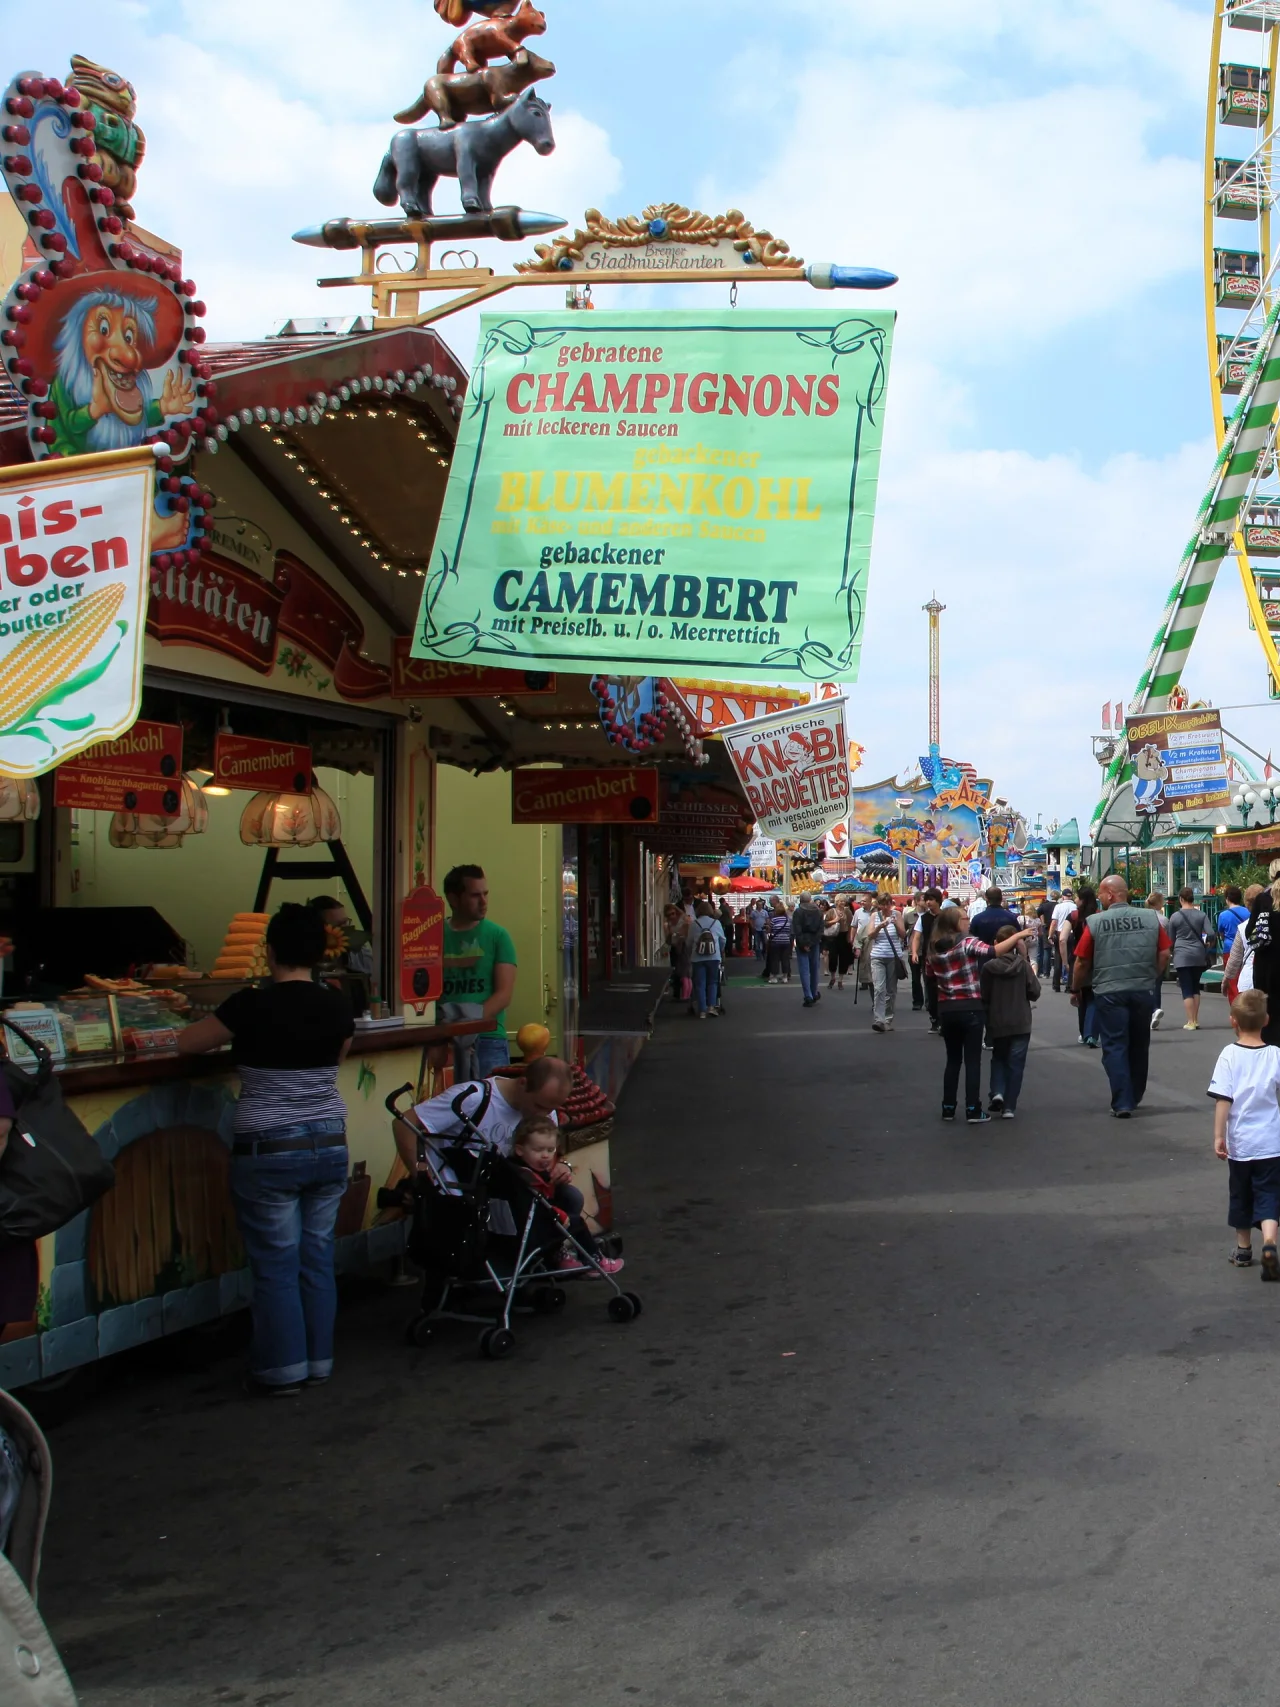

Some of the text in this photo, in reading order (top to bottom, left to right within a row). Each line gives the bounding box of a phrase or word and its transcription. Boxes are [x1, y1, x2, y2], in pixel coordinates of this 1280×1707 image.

[585, 252, 726, 269] Stadtmusikanten
[645, 244, 687, 257] Bremer
[557, 342, 663, 366] gebratene
[506, 372, 840, 417] CHAMPIGNONS
[502, 418, 679, 437] mit leckeren Saucen
[633, 443, 761, 470] gebackener
[495, 470, 821, 521] BLUMENKOHL
[491, 517, 767, 543] mit Käse- und anderen Saucen
[0, 536, 128, 590] ben
[540, 542, 665, 568] gebackener
[29, 582, 84, 607] oder
[493, 570, 797, 624] CAMEMBERT
[491, 616, 527, 635] mit
[531, 617, 606, 638] Preiselb.
[614, 624, 631, 638] u.
[648, 625, 663, 640] o.
[670, 622, 780, 645] Meerrettich
[752, 719, 825, 743] Ofenfrische
[1128, 714, 1178, 741] OBELIX
[219, 747, 295, 777] Camembert
[80, 773, 169, 792] Knoblauchbaguettes
[516, 772, 637, 813] Camembert
[746, 762, 849, 818] BAGUETTES
[940, 779, 988, 807] SKATER
[666, 801, 739, 813] SCHIESSEN
[768, 802, 844, 828] mit verschiedenen
[791, 816, 826, 832] Belägen
[402, 911, 443, 945] Baguettes
[1103, 916, 1145, 932] DIESEL
